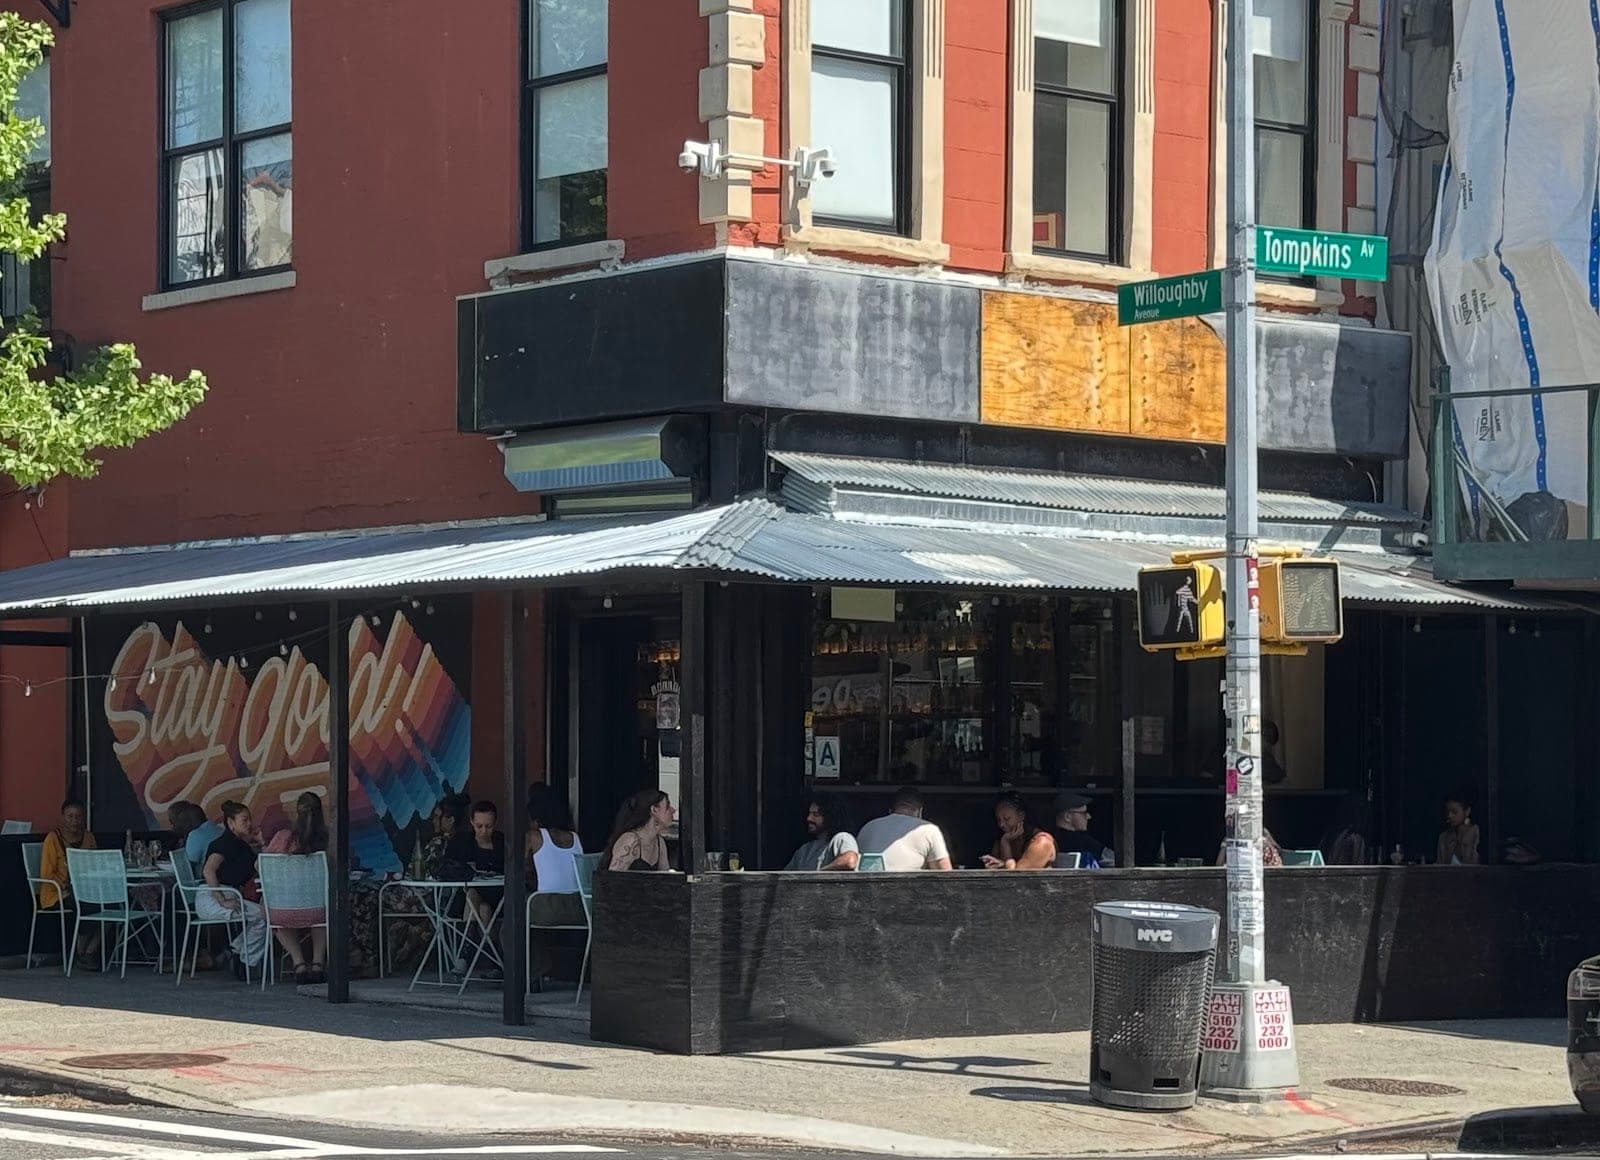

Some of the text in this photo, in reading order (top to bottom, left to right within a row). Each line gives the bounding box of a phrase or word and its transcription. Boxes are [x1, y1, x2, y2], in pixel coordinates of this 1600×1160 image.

[1264, 231, 1375, 272] Tompkins Av
[1133, 276, 1209, 308] Willoughby
[1134, 308, 1160, 321] Avenue
[104, 620, 235, 813] Stay
[820, 741, 836, 766] A
[1137, 928, 1173, 942] NYC
[1212, 994, 1240, 1006] ASH
[1208, 1015, 1237, 1026] (516)
[1259, 1014, 1285, 1025] (516)
[1208, 1026, 1234, 1038] 232
[1261, 1025, 1284, 1037] 232
[1204, 1038, 1238, 1050] 0007
[1258, 1036, 1288, 1048] 0007
